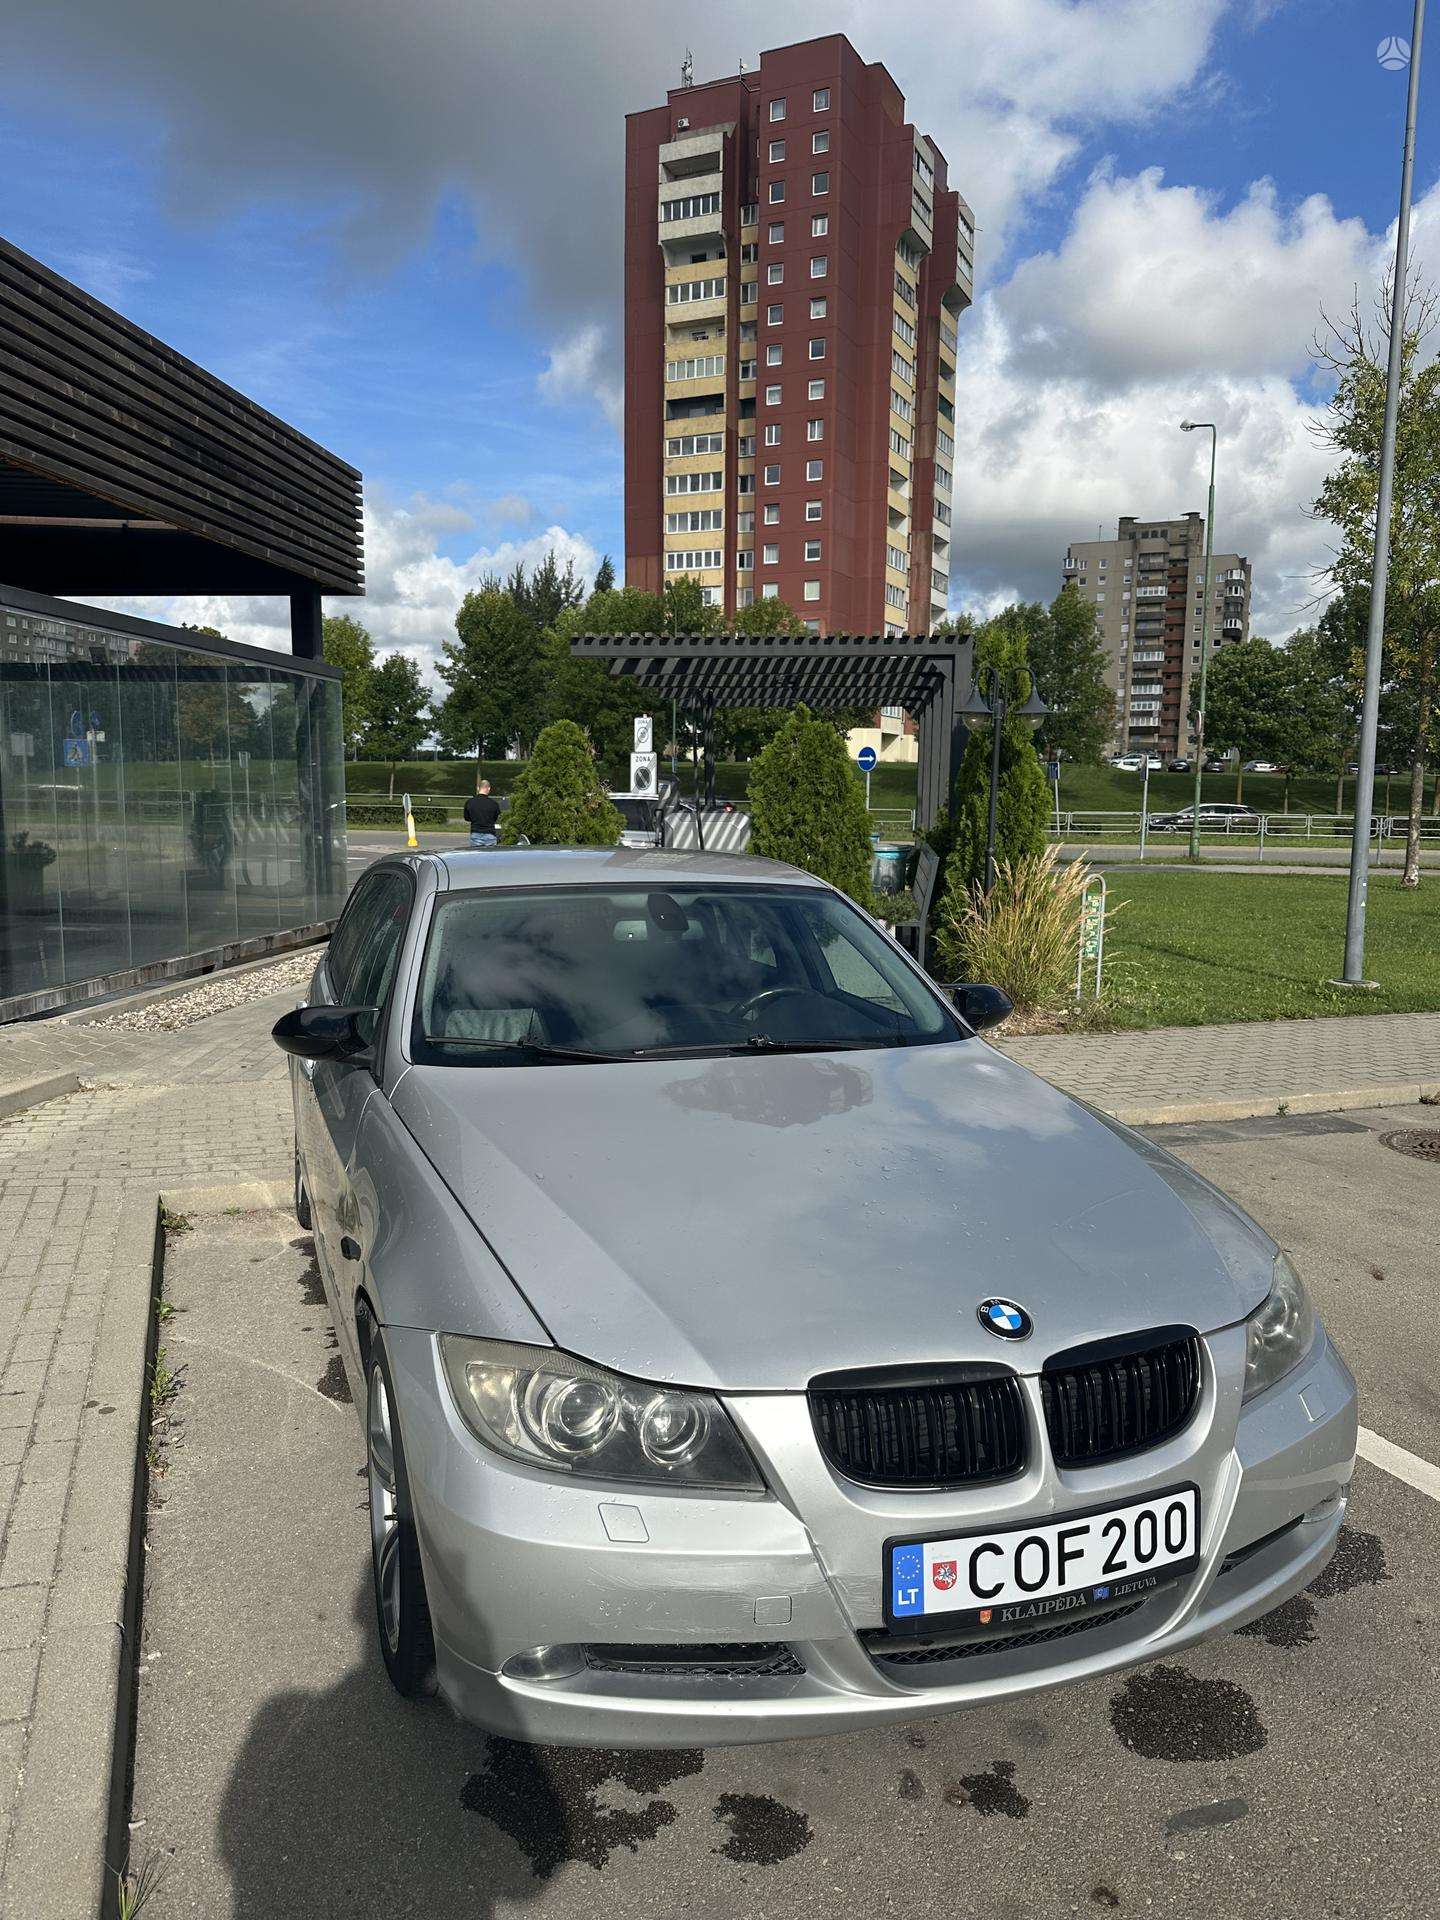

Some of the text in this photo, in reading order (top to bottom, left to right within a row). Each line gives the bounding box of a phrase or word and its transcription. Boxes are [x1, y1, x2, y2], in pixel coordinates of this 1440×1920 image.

[898, 1501, 1187, 1606] LT COF 200
[1000, 1576, 1158, 1622] KLAIPĖDA LIETUVA
